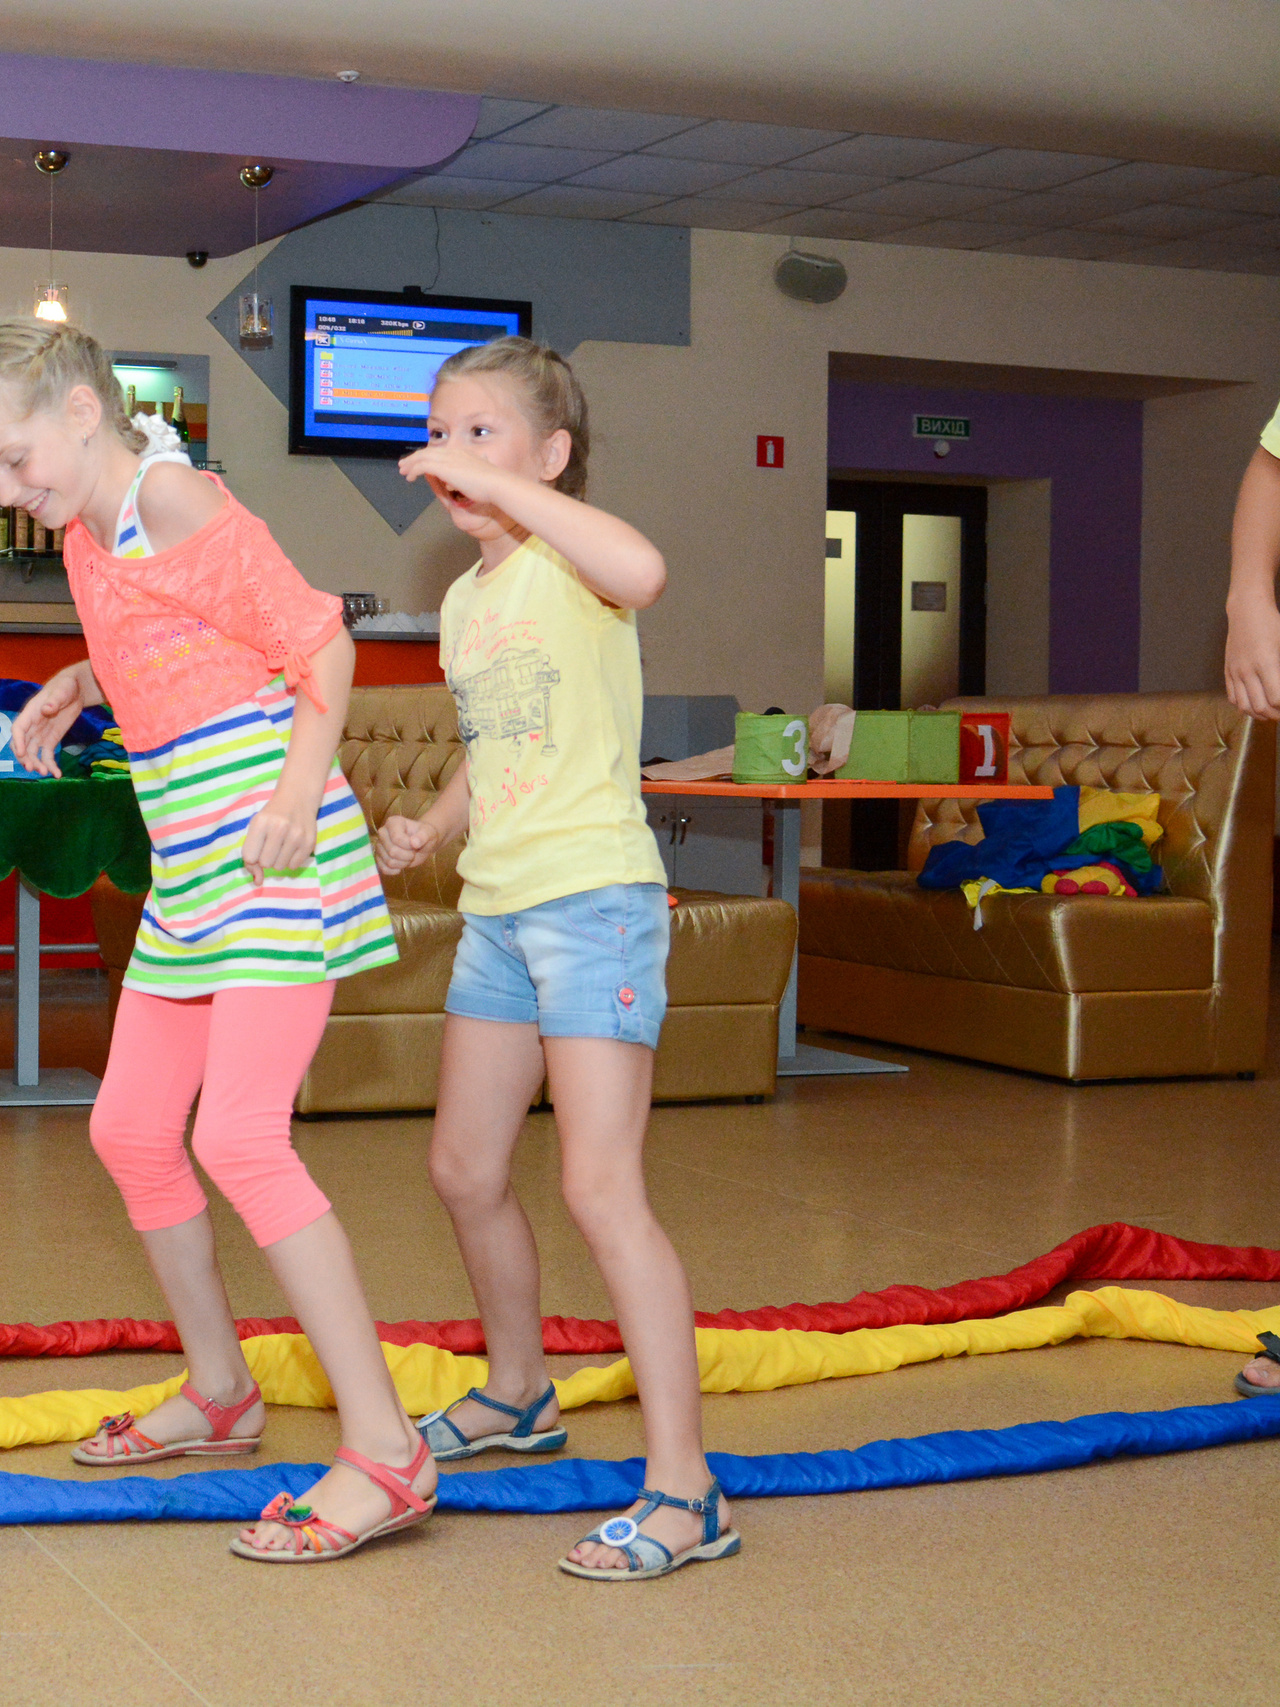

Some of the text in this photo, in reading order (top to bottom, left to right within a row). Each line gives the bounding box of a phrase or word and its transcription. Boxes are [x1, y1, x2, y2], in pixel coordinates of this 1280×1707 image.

[920, 419, 966, 436] ВИХІД
[781, 720, 806, 776] 3
[974, 724, 997, 776] 1
